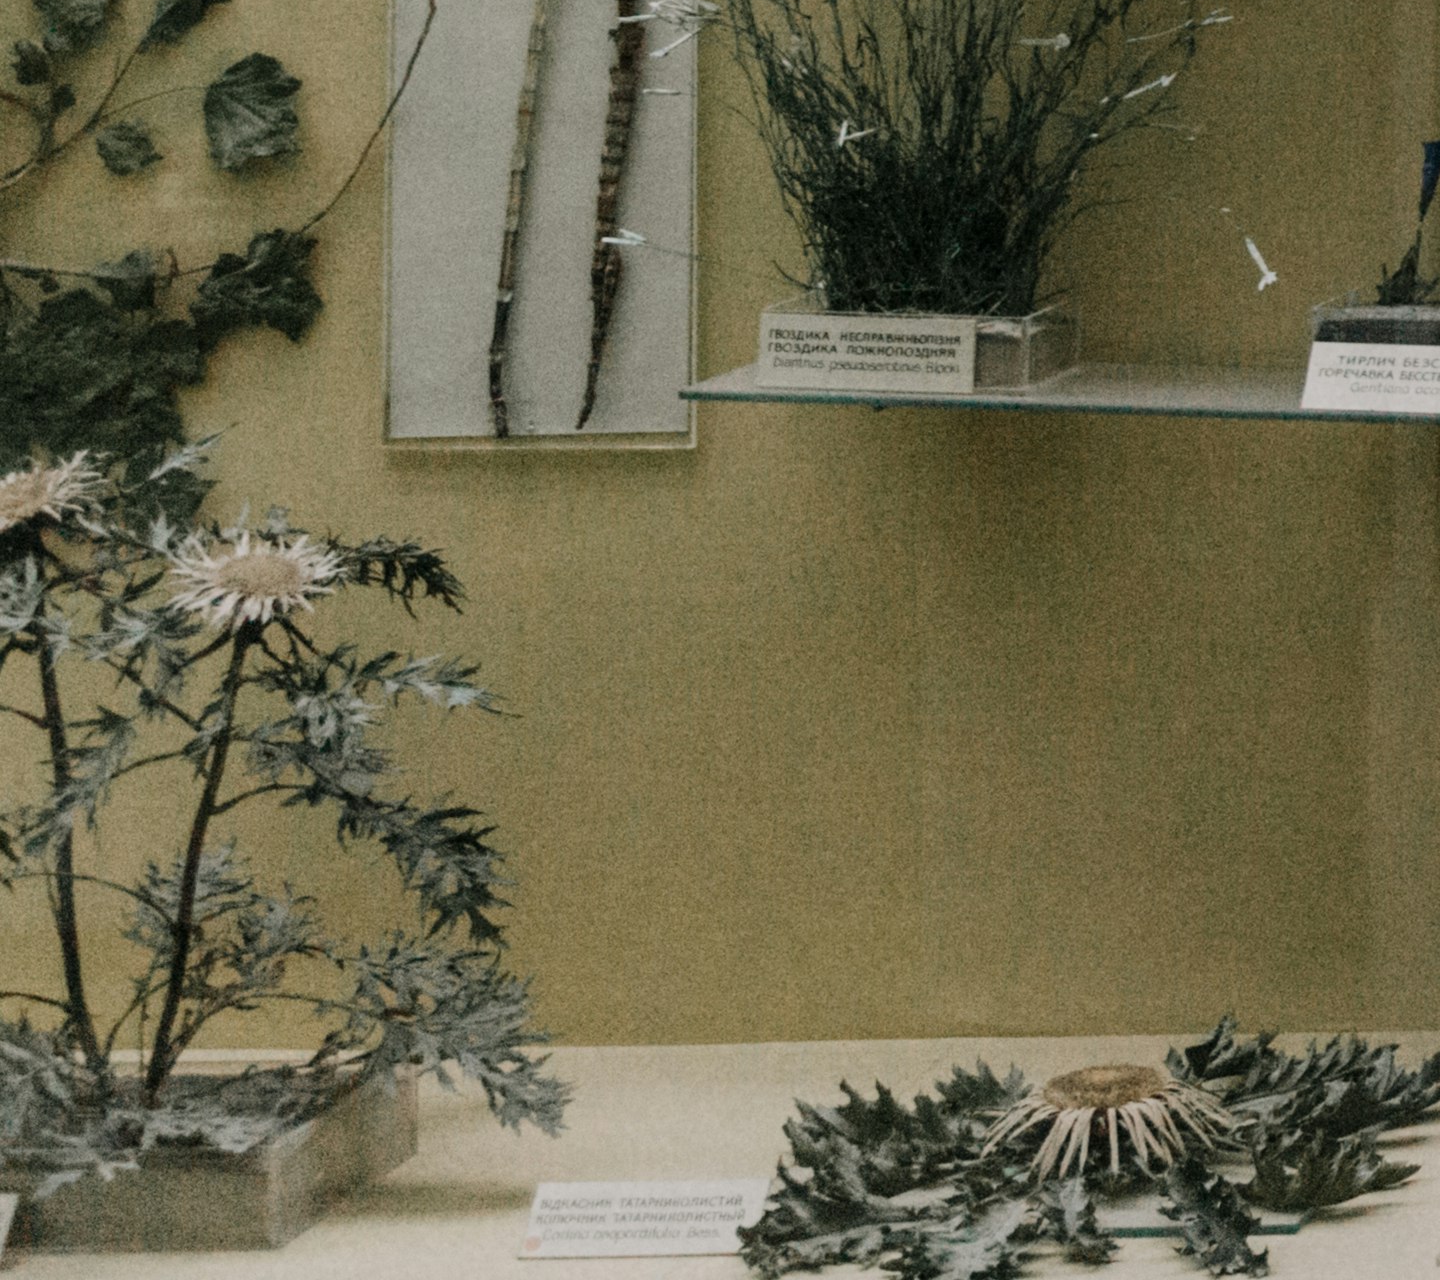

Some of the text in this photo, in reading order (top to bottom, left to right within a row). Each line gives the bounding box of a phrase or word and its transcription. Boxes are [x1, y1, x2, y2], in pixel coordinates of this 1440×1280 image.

[769, 329, 830, 341] ГВОЗДИКА
[767, 343, 956, 359] ГВОЗДИКА ЛОЖНОПОЗДНЯЯ
[1338, 355, 1396, 367] ТИРЛИЧ
[1318, 368, 1394, 381] ГОРЕЧАВКА
